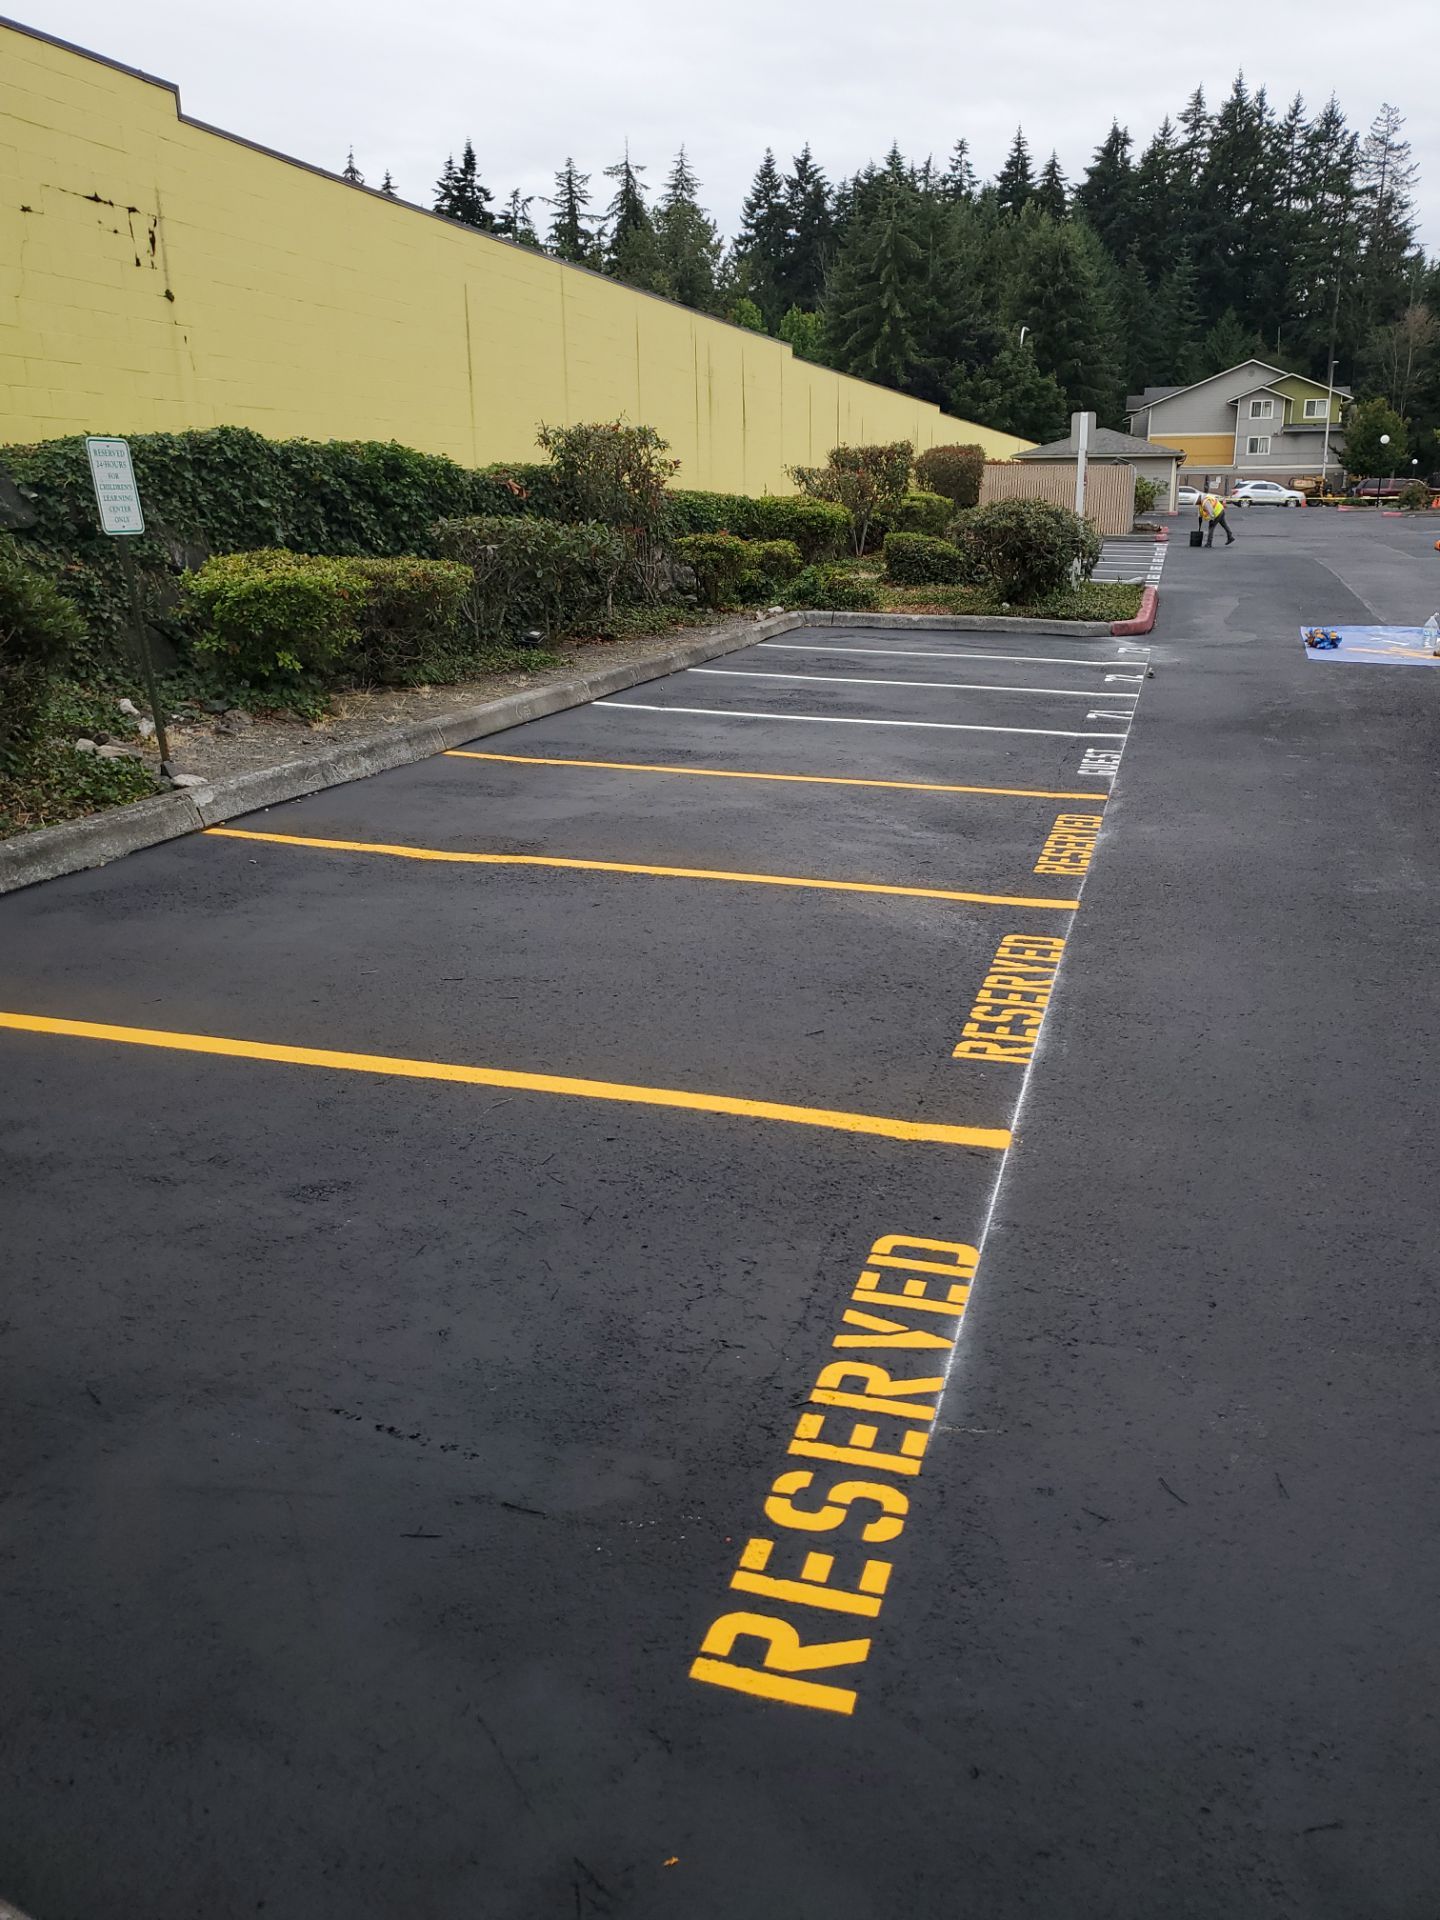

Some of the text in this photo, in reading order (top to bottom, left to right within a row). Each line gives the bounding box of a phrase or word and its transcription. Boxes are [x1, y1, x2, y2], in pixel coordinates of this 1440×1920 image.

[93, 449, 125, 457] RESERVED
[1086, 709, 1134, 719] 71
[1077, 748, 1122, 775] GUEST
[1033, 814, 1104, 875] RESERVED
[952, 934, 1066, 1064] RESERVED
[689, 1234, 981, 1715] RESERVED
